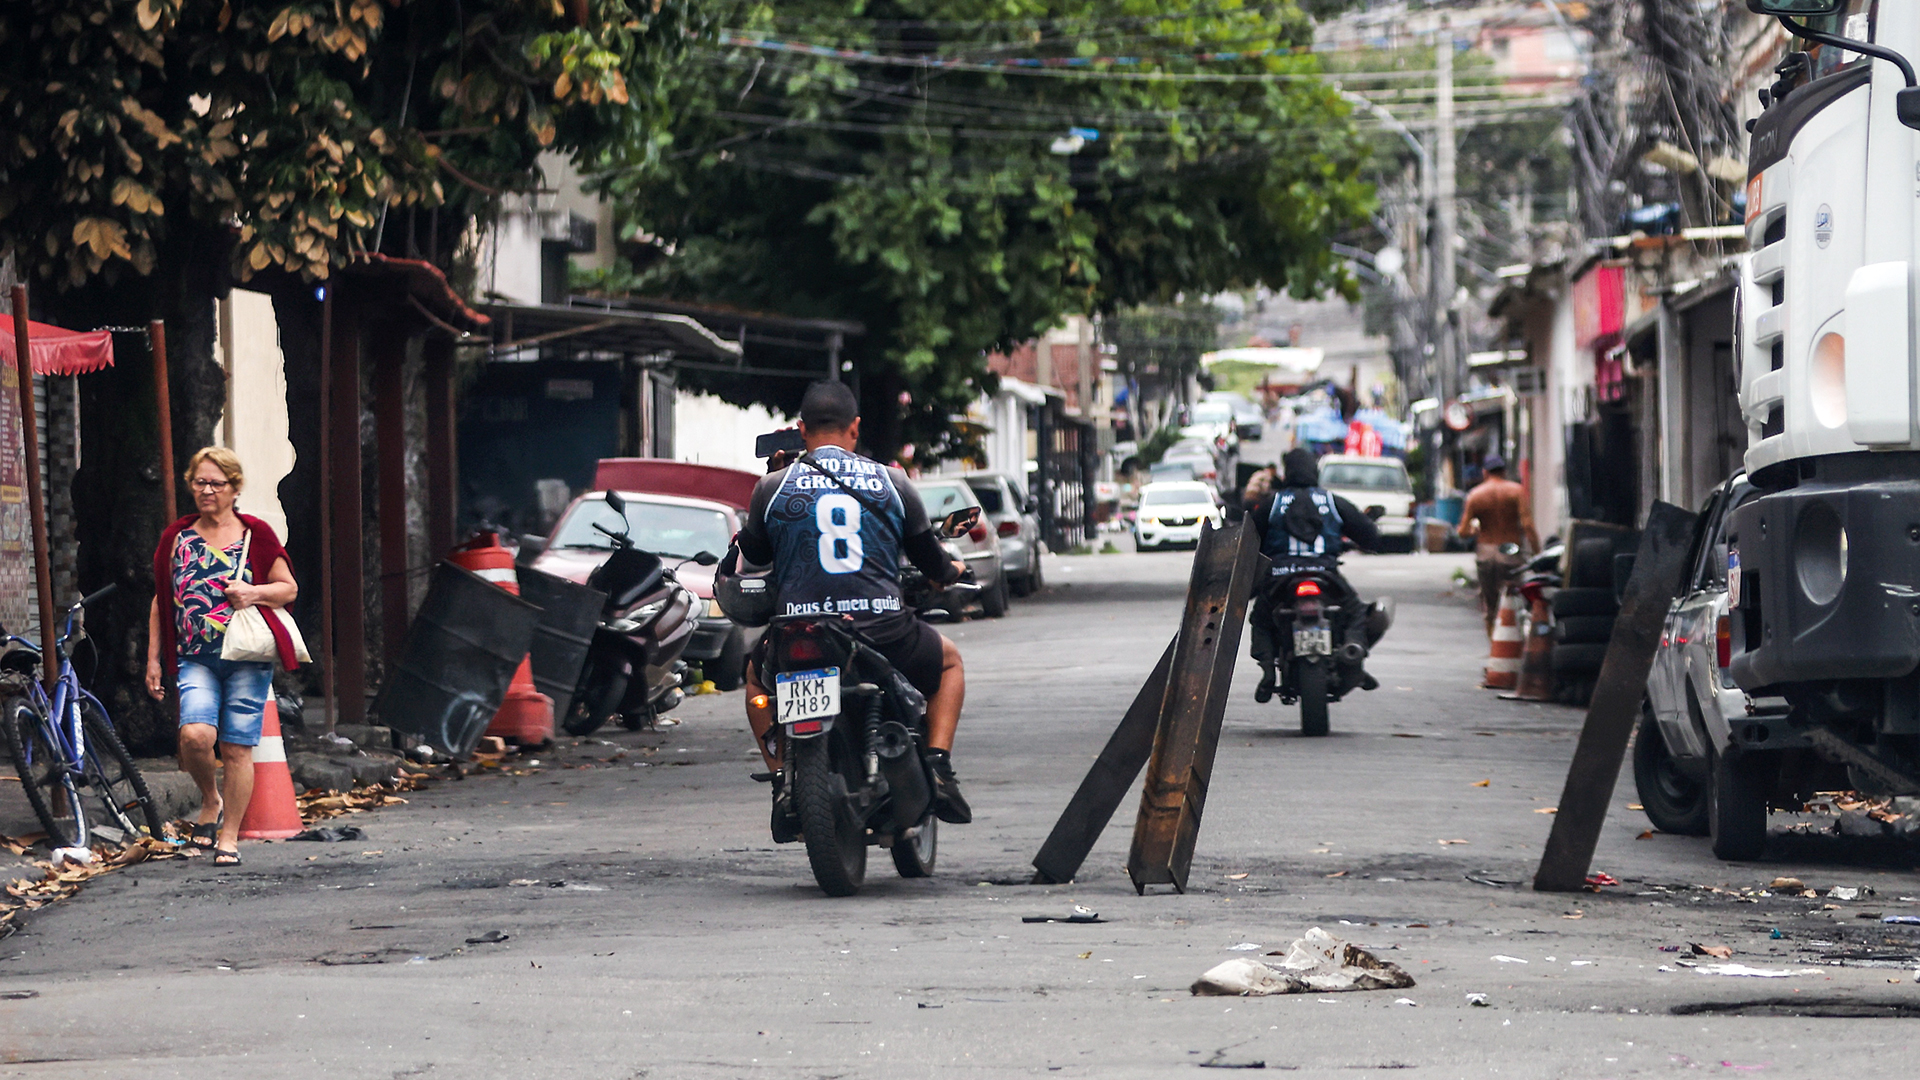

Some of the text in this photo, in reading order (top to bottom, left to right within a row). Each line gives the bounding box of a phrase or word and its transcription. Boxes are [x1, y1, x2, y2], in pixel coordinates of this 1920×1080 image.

[795, 474, 883, 491] GROTÃO
[816, 493, 863, 574] 8
[786, 602, 821, 616] Deus
[823, 596, 834, 613] é
[836, 598, 870, 612] meu
[790, 678, 825, 698] RKM
[785, 695, 830, 717] 7H89
